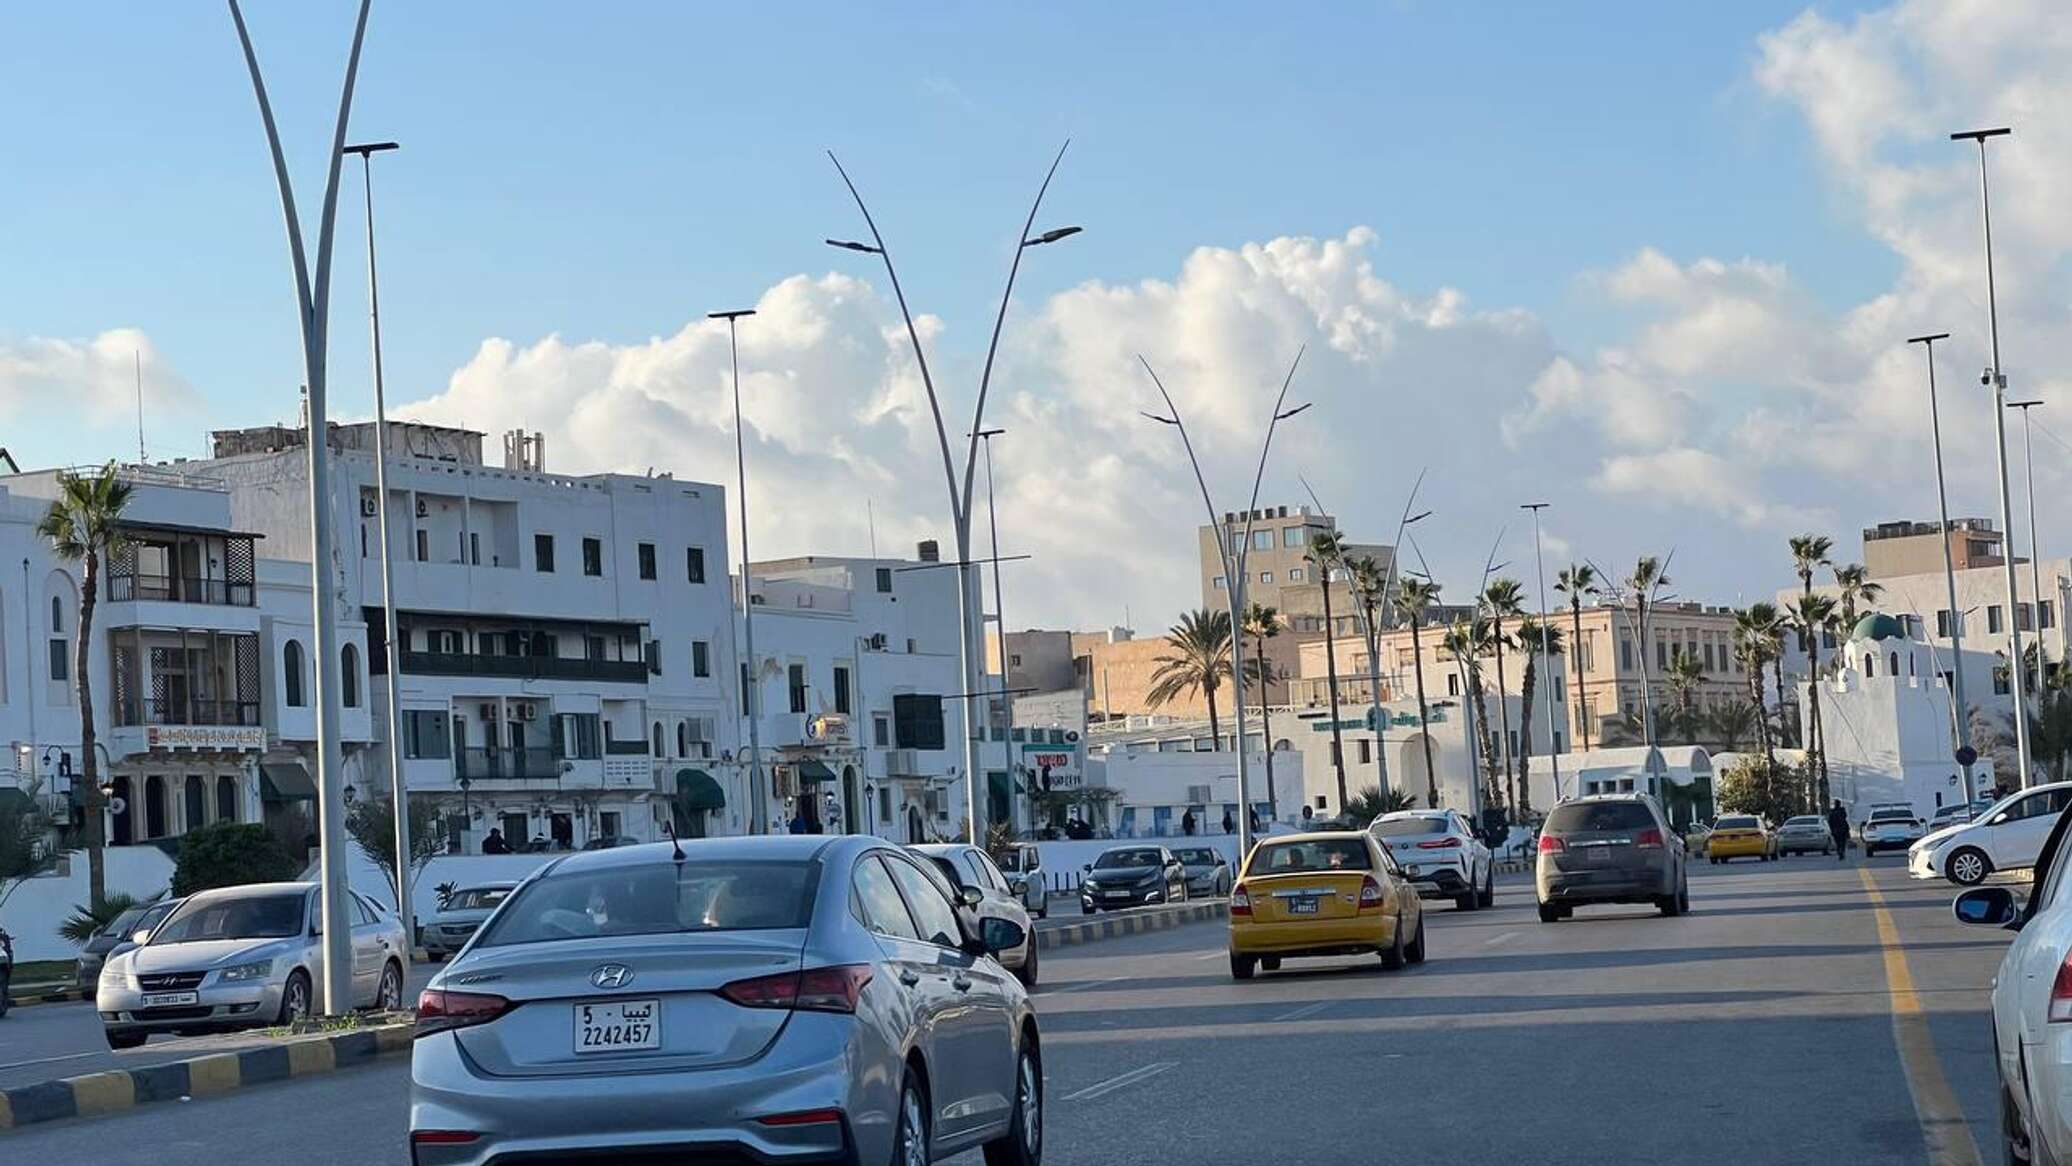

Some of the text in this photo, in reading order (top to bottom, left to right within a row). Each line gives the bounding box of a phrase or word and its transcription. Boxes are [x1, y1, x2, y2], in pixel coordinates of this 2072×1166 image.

[583, 1006, 592, 1024] 5
[622, 1004, 651, 1022] ليبيا
[583, 1024, 651, 1046] 2242457
